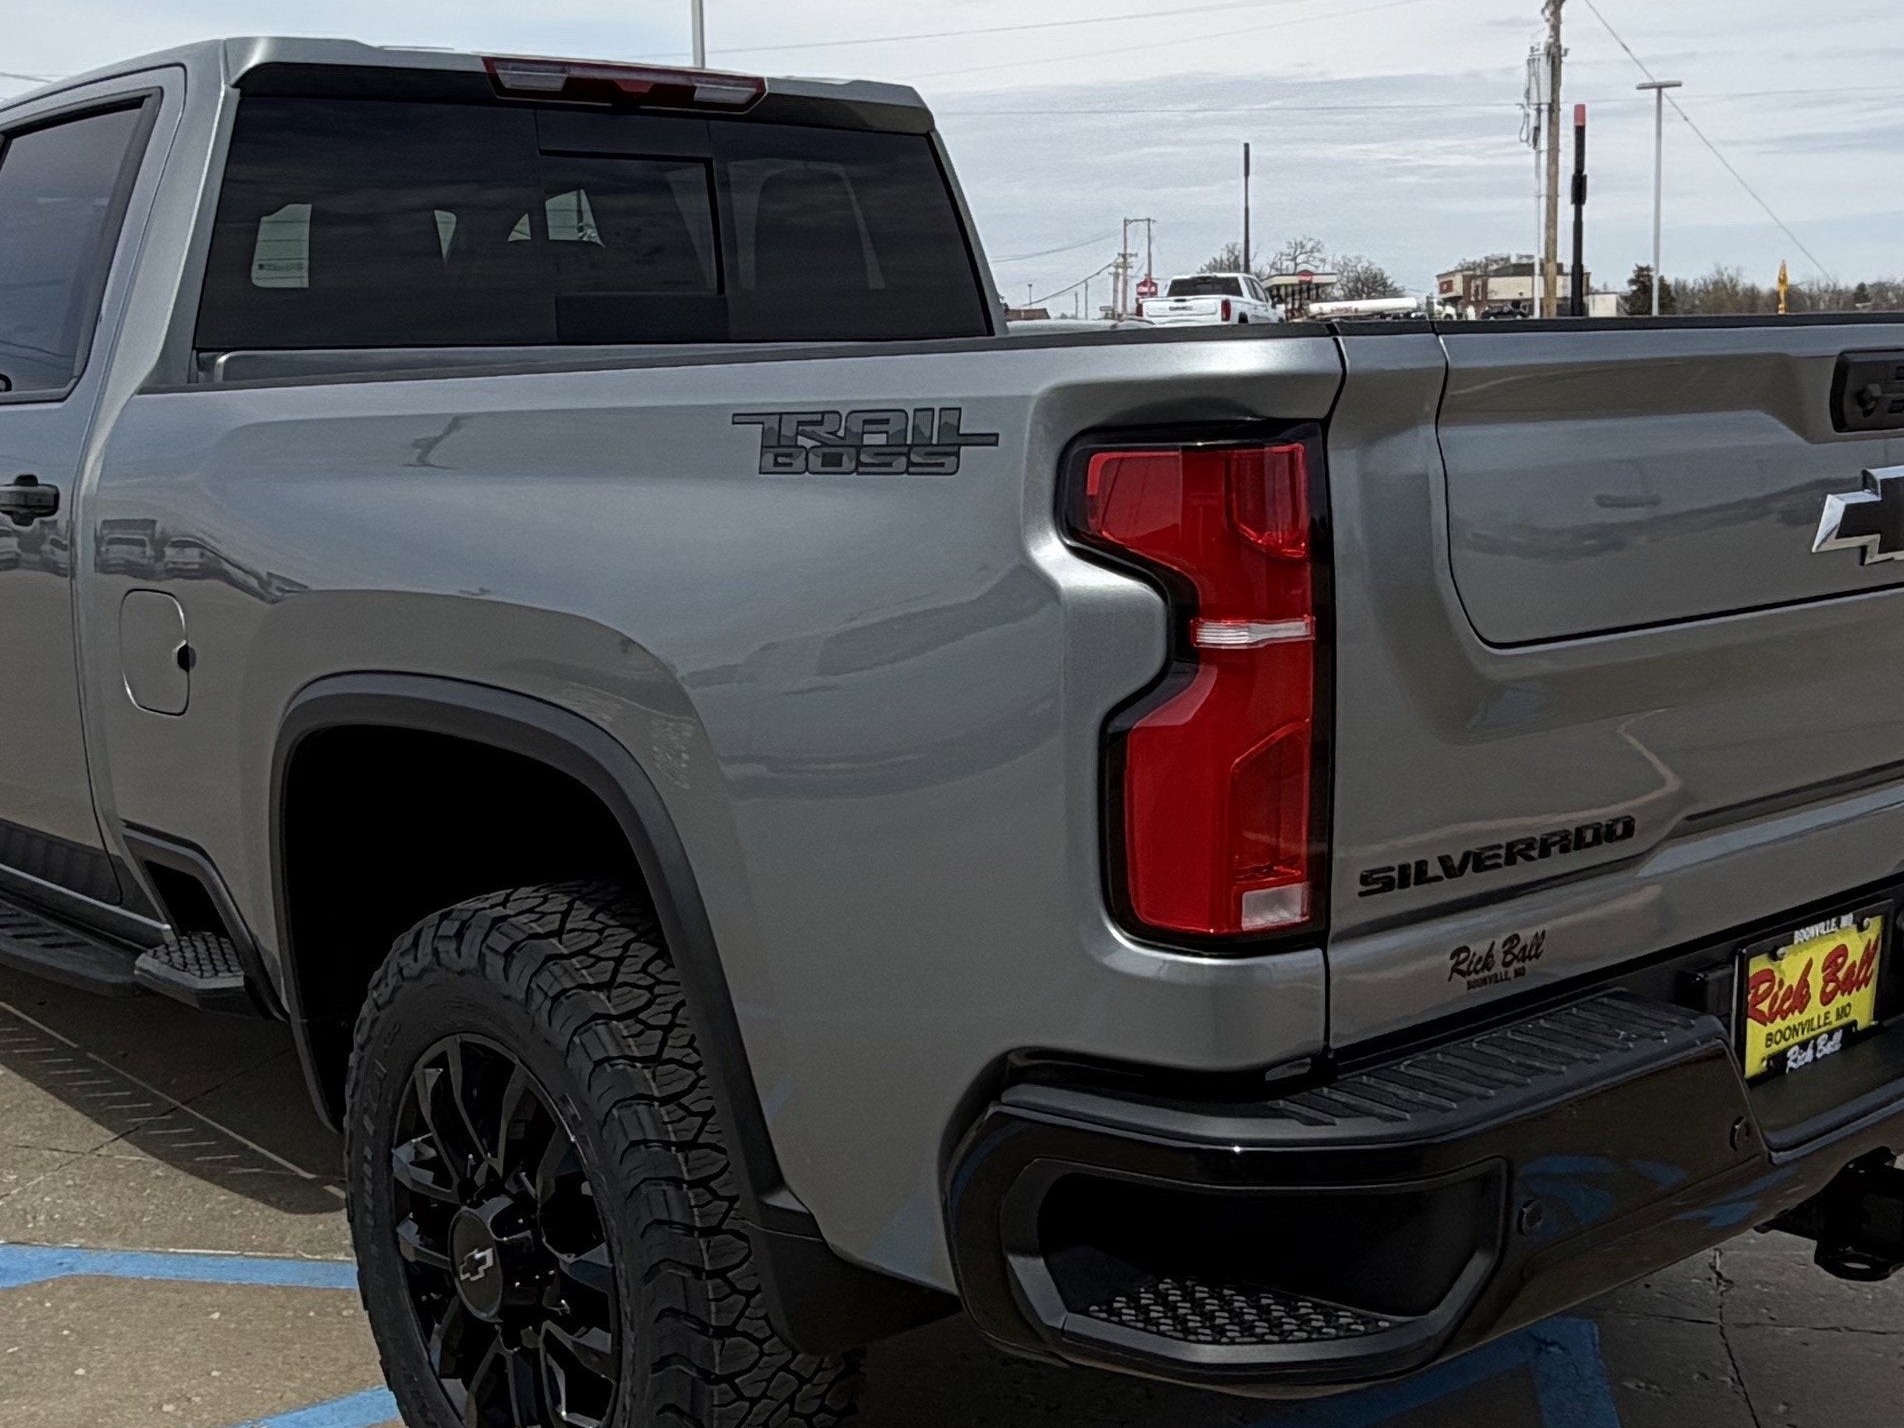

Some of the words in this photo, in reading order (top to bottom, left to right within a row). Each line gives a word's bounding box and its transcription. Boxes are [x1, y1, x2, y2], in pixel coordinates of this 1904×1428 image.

[731, 406, 1000, 448] TRAIL
[758, 444, 961, 476] BOSS
[1357, 815, 1637, 898] SILVERADO
[1447, 941, 1496, 983] Rick
[1501, 928, 1546, 969] Ball
[1748, 967, 1814, 1028] Rick
[1819, 935, 1881, 1008] Ball
[1835, 1001, 1853, 1021] MO
